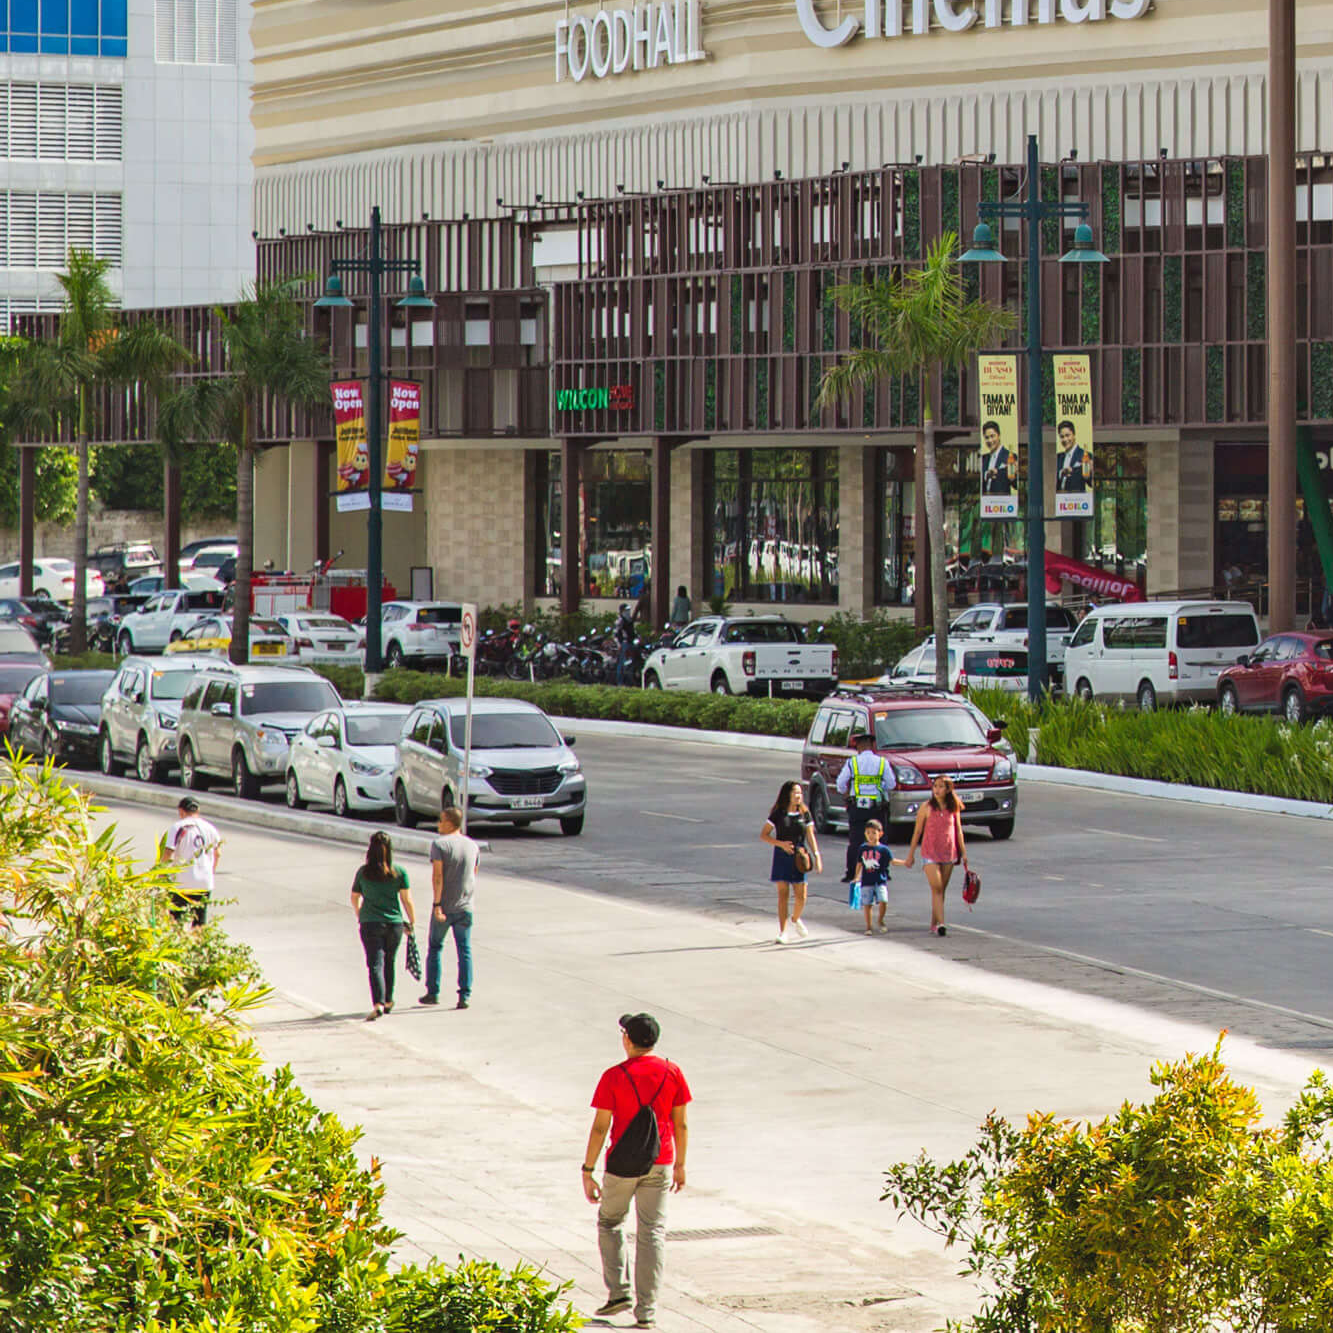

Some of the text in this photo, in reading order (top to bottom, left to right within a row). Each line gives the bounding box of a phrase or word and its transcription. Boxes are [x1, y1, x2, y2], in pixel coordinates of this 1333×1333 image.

[334, 388, 359, 399] Now
[392, 387, 418, 398] Now
[556, 387, 609, 411] WILCON
[983, 393, 1015, 405] TAMA KA
[1057, 393, 1090, 404] TAMA KA
[334, 399, 362, 412] Open
[391, 398, 419, 411] Open
[987, 404, 1011, 415] DIYAN!
[1062, 404, 1086, 415] DIYAN!
[985, 505, 1014, 513] ILOILO
[1060, 503, 1088, 512] ILOILO
